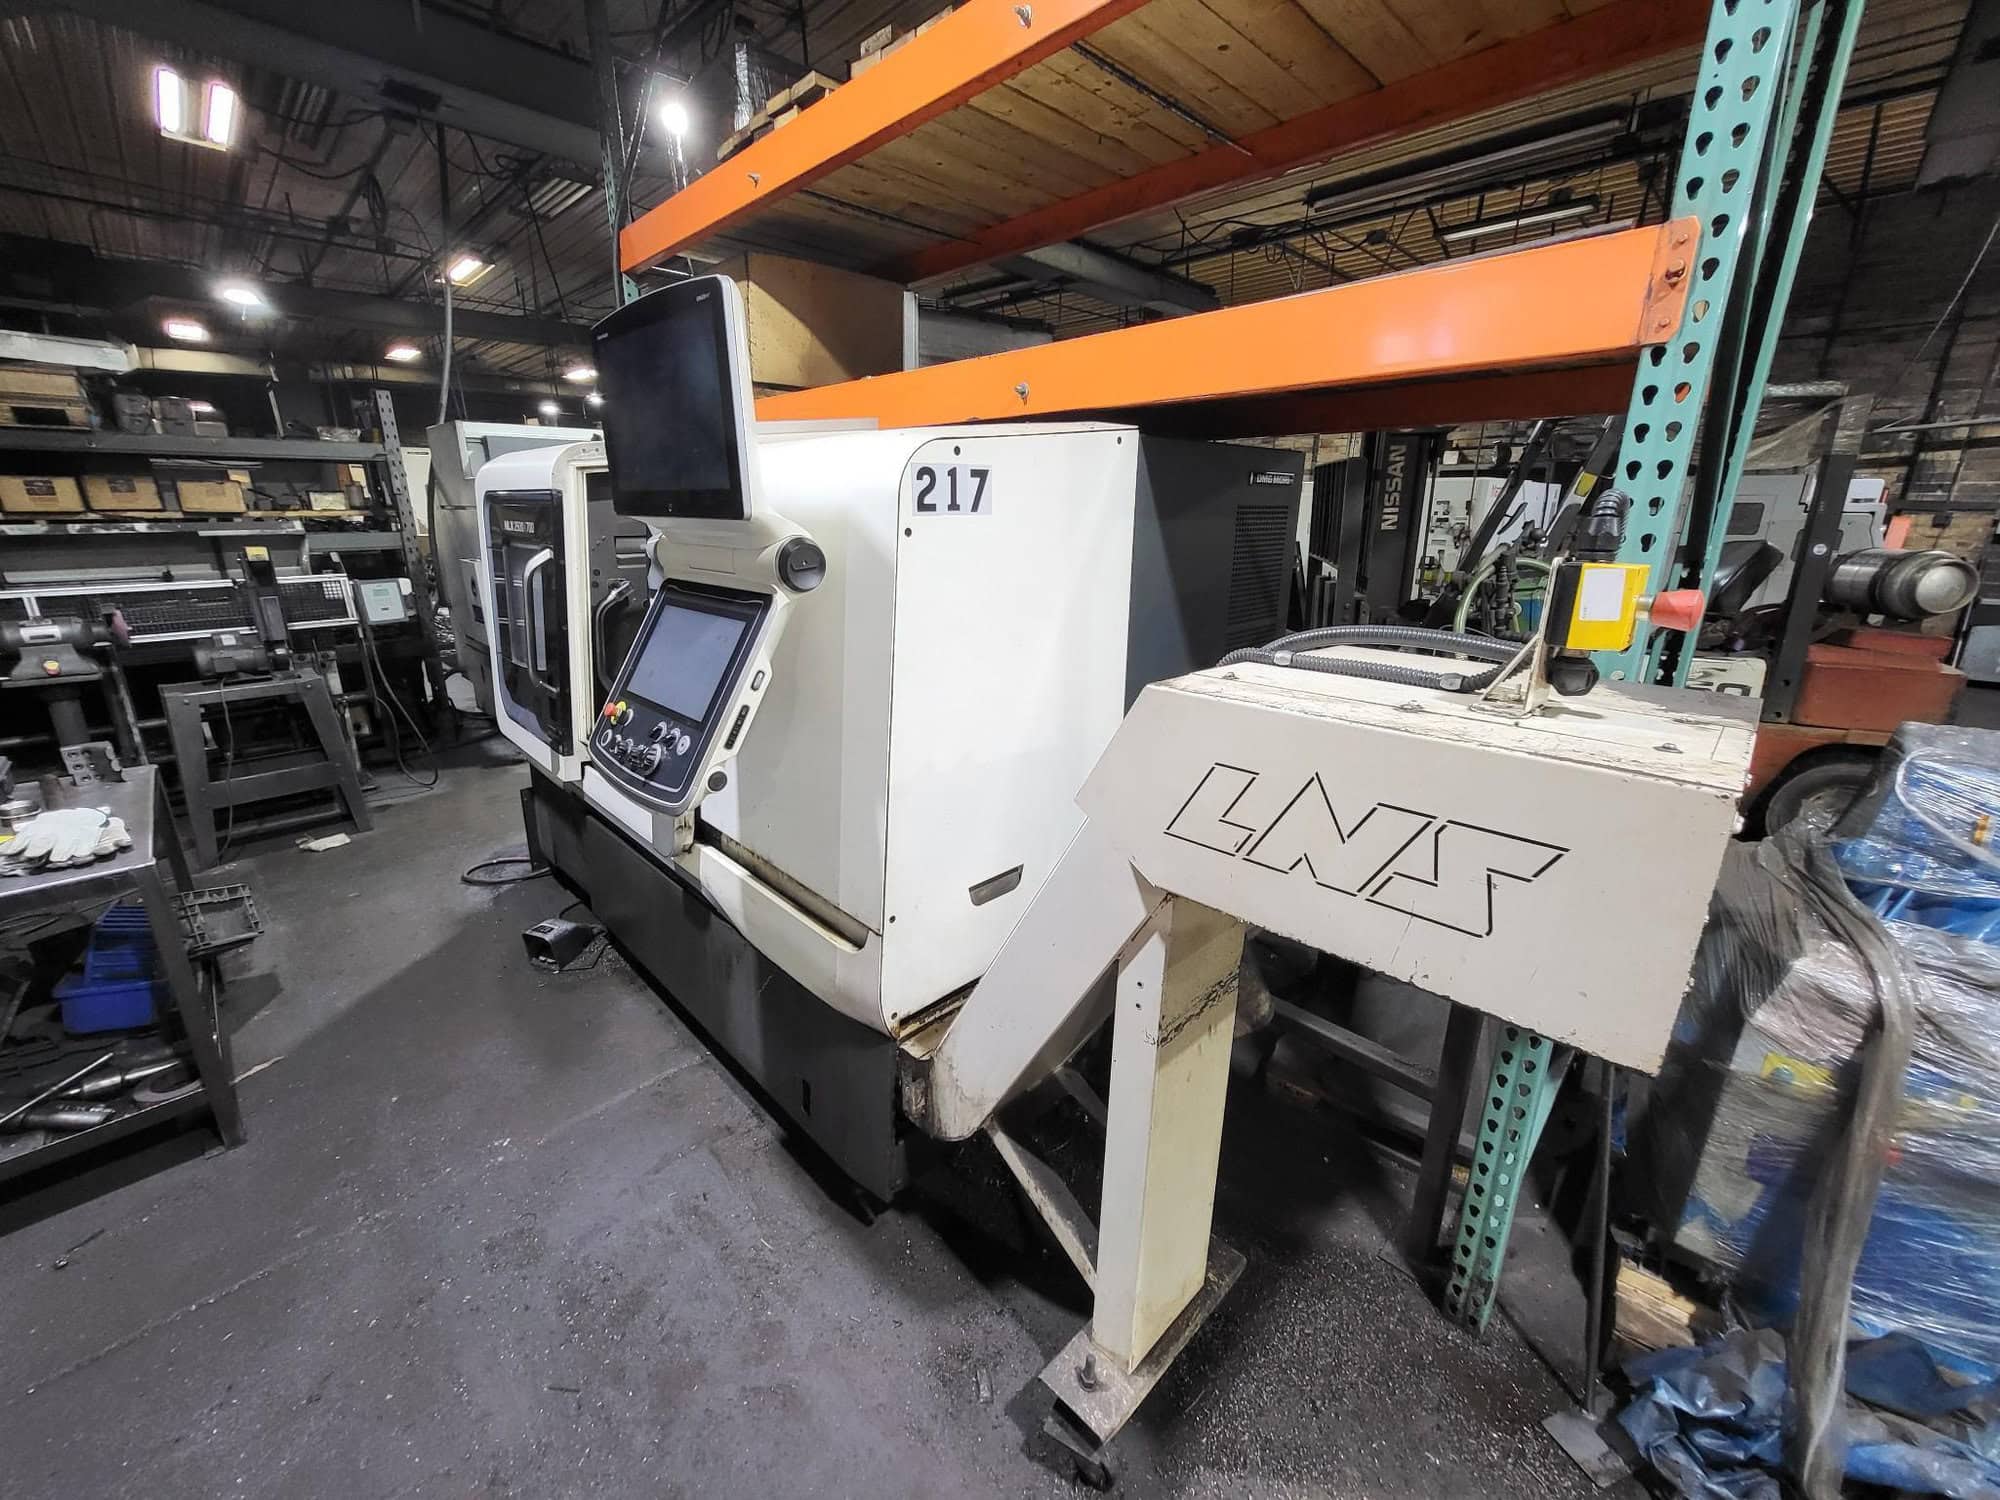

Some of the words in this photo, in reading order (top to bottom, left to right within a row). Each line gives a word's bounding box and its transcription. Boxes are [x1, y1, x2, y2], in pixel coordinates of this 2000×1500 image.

[916, 466, 990, 513] 217
[1381, 445, 1407, 530] NISSAN
[1163, 761, 1572, 939] LNS
